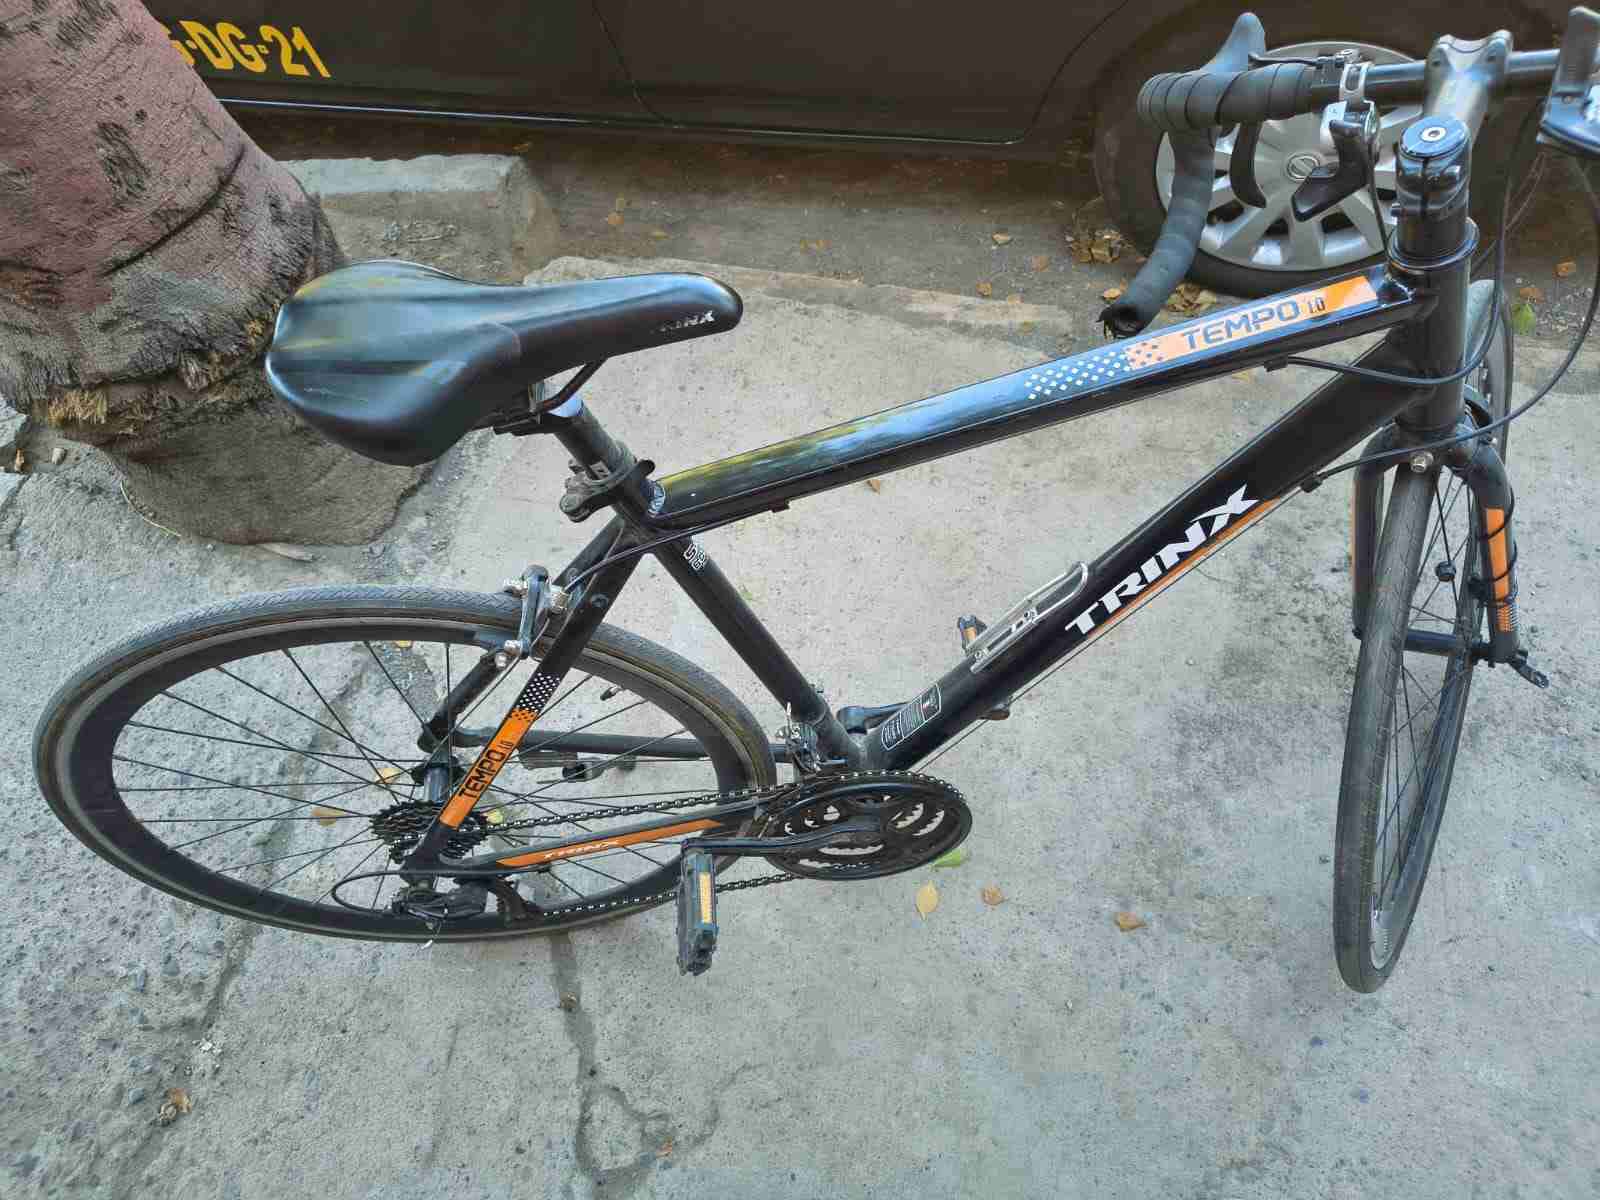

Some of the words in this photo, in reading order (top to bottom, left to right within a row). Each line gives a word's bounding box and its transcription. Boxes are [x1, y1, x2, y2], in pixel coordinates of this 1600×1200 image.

[1181, 300, 1300, 350] TEMPO
[1307, 295, 1326, 315] 1.0
[1064, 483, 1260, 635] TRINX
[458, 748, 507, 799] TEMPO
